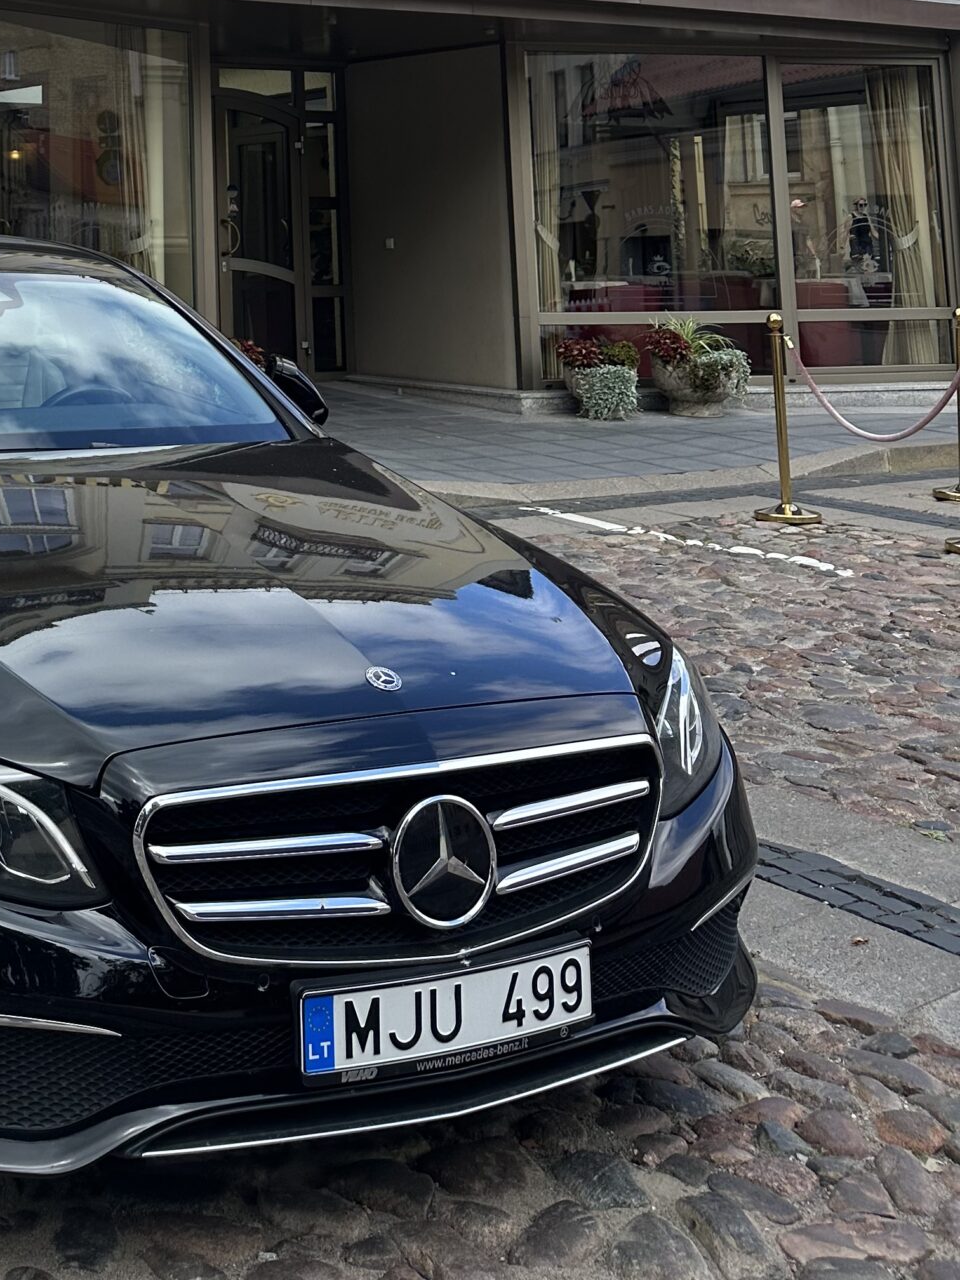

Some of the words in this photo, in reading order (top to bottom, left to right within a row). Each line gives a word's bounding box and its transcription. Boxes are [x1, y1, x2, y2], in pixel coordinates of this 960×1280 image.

[308, 1041, 331, 1060] LT
[344, 983, 462, 1060] MJU
[502, 957, 583, 1028] 499
[416, 1037, 529, 1072] www.mercedes-benz.lt
